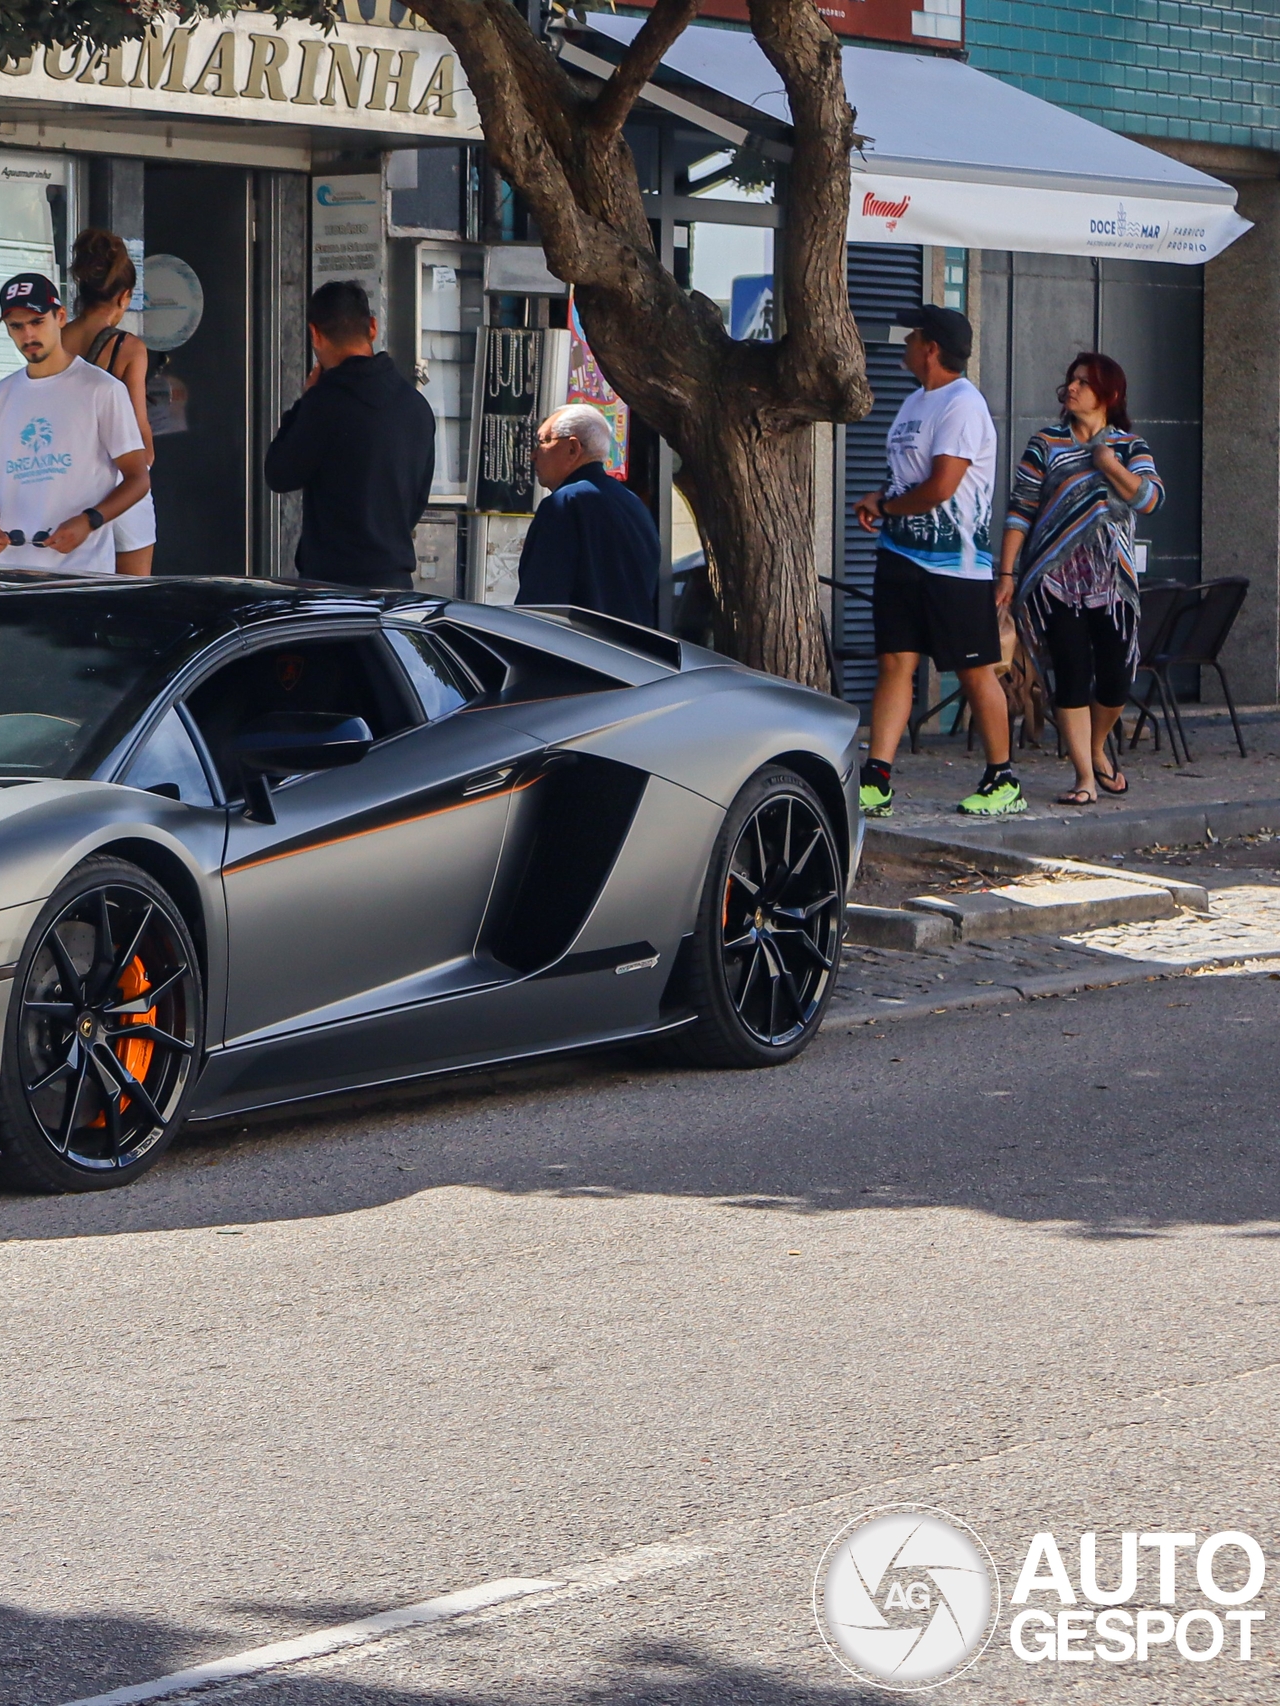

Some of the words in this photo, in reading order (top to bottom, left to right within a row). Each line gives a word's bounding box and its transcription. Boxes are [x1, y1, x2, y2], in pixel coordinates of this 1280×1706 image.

[1, 166, 52, 180] Aguamarinha
[1090, 219, 1116, 235] DOCE
[1140, 225, 1161, 239] MAR
[1173, 226, 1206, 238] FABRICO
[1166, 240, 1207, 253] PRÓPRIO
[6, 282, 34, 300] 93
